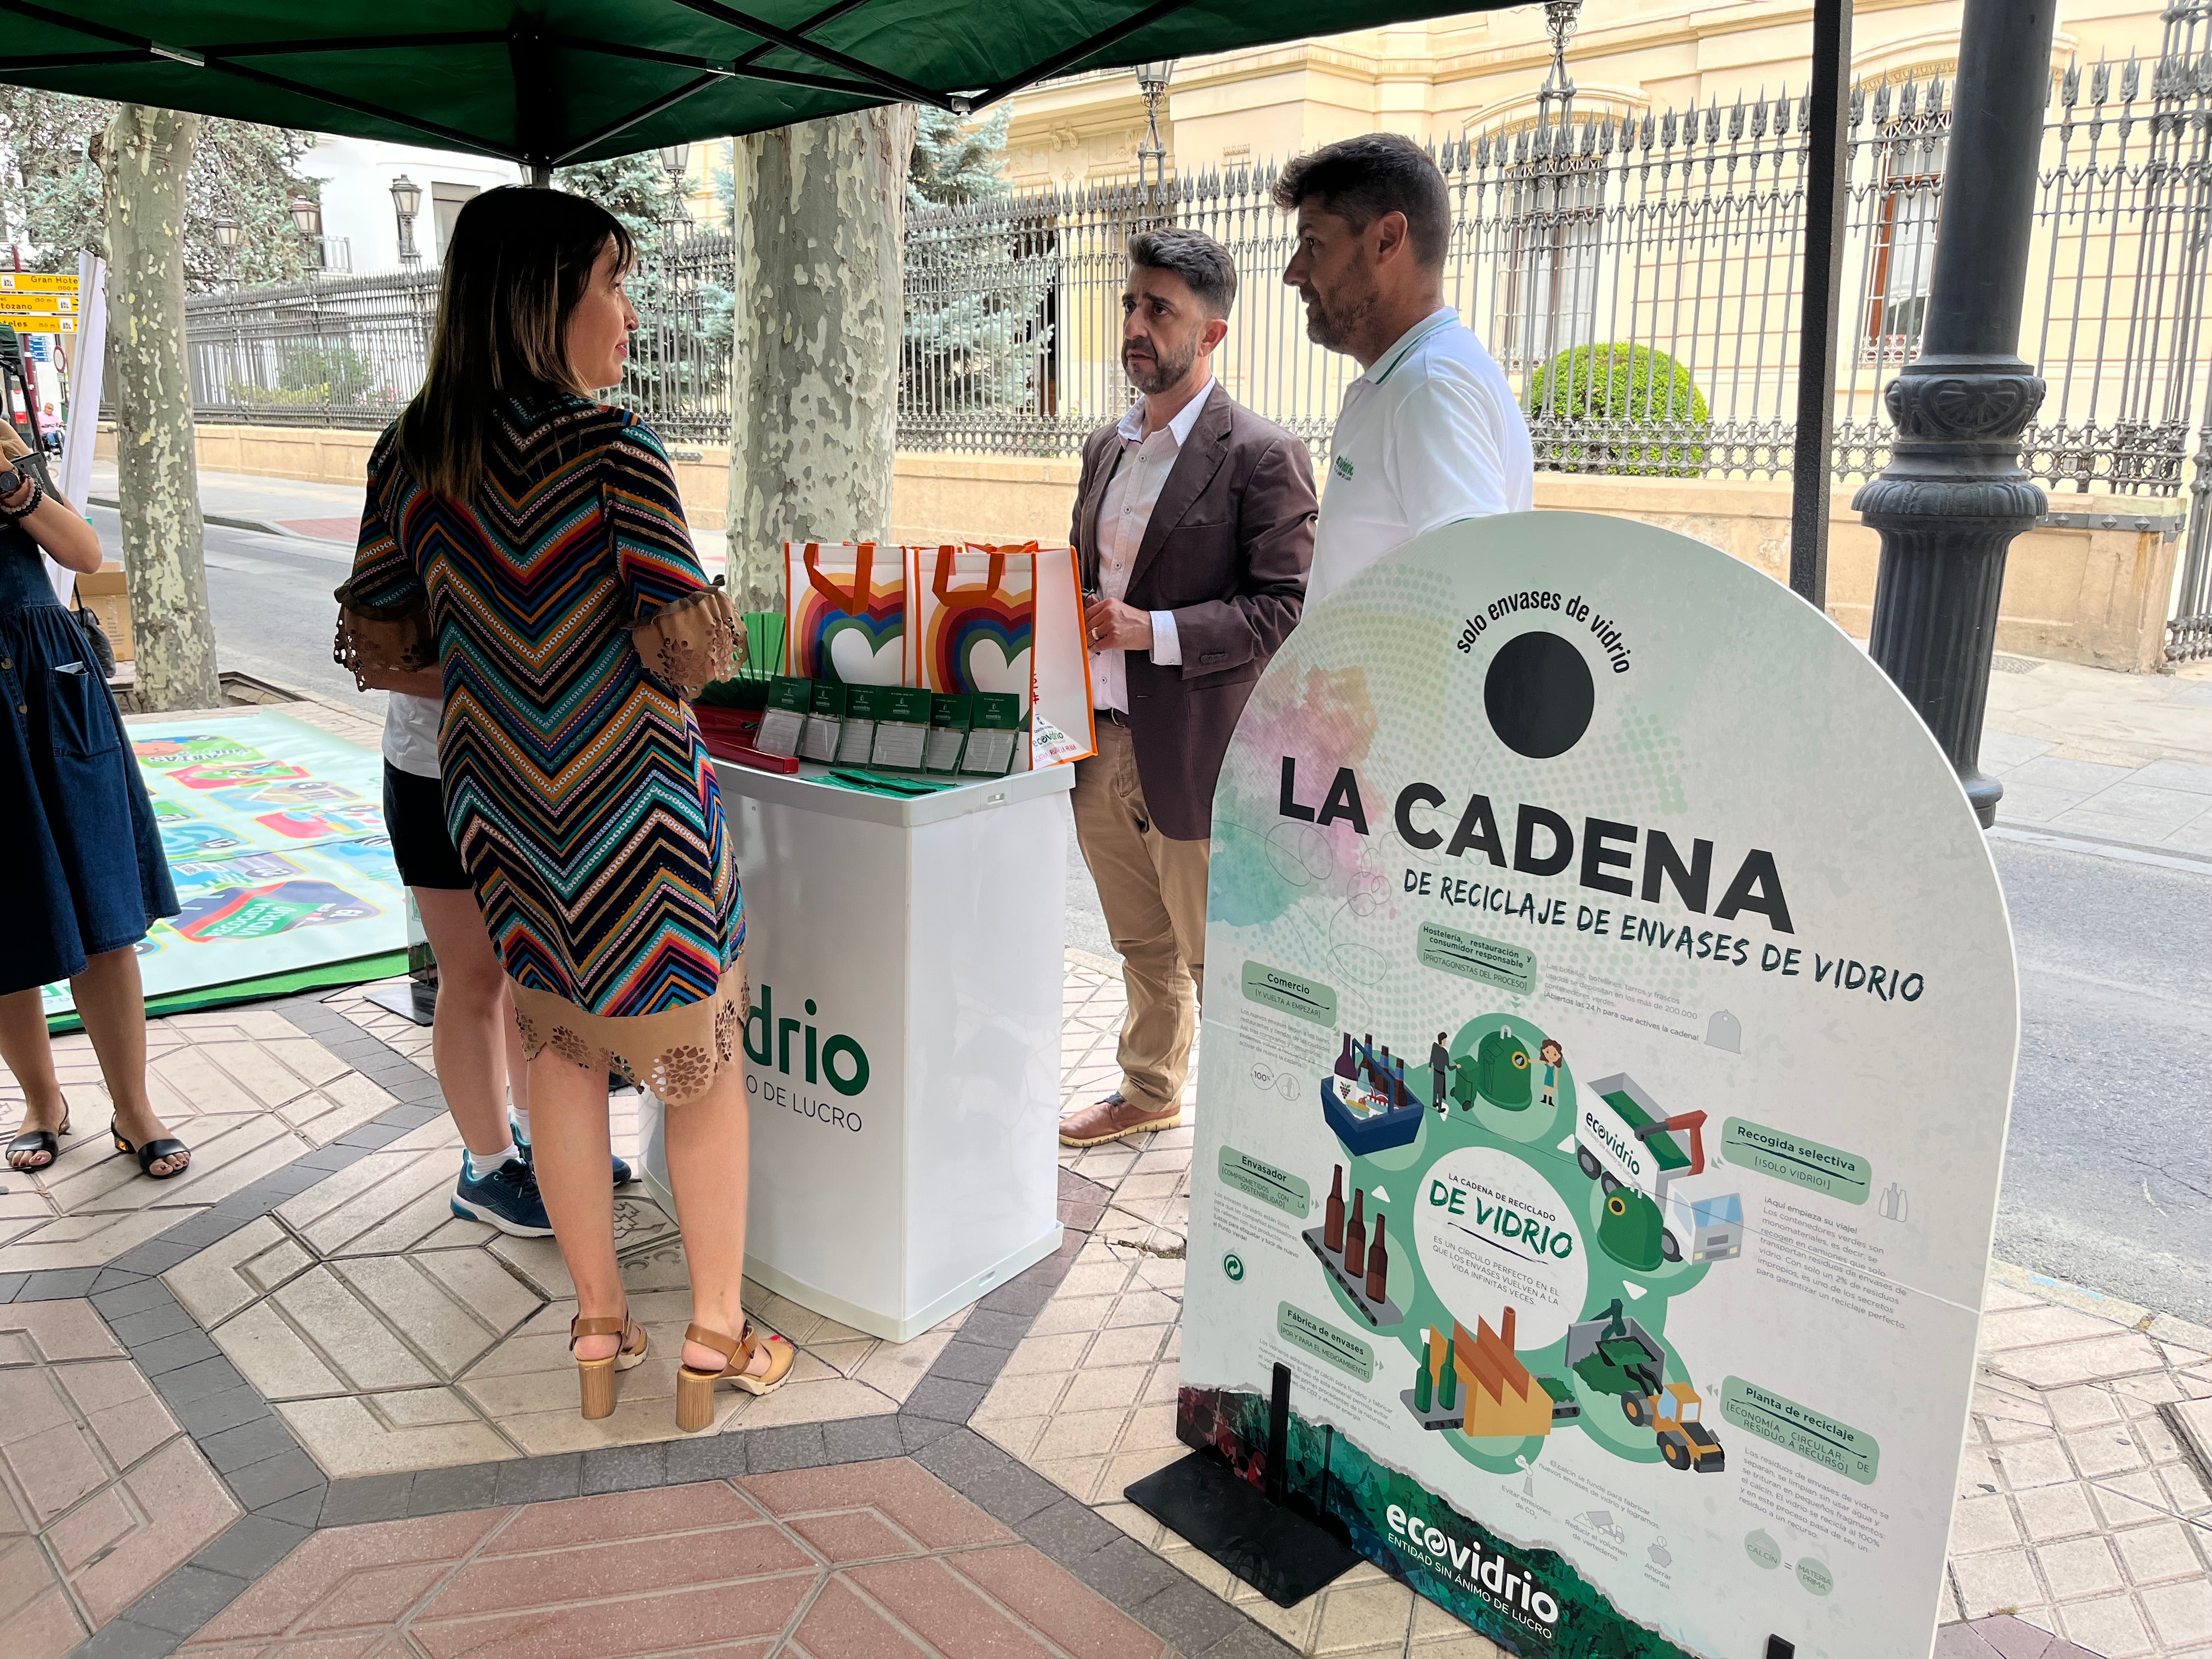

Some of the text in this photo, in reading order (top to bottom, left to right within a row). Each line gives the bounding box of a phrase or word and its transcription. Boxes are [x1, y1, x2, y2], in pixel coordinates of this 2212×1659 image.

[1458, 591, 1630, 673] solo envases de vidrio
[1032, 730, 1064, 747] ecovidrio
[1279, 755, 1795, 935] LA CADENA
[204, 902, 297, 937] RECOGIDA VIDRIO
[1404, 868, 1925, 1004] DE RECICLAJE DE ENVASES DE VIDRIO
[1423, 926, 1463, 944] Hostelería,
[1470, 939, 1519, 958] restauración
[1423, 952, 1527, 990] [PROTAGONISTAS DEL PROCESO]
[1430, 937, 1523, 968] consumidor responsable
[1255, 989, 1261, 997] [Y
[1263, 993, 1284, 1005] VUELTA
[1292, 1002, 1321, 1018] EMPEZAR]
[1267, 973, 1310, 994] Comercio
[1575, 1000, 1584, 1008] las
[1602, 1009, 1618, 1018] para
[1620, 1014, 1633, 1023] que
[1635, 1019, 1660, 1030] actives
[1670, 1029, 1699, 1041] cadena!
[1254, 1071, 1270, 1081] 100%
[764, 1081, 786, 1108] DE
[793, 1093, 862, 1132] LUCRO
[1585, 1112, 1640, 1175] ecovidrio
[1737, 1126, 1855, 1171] Recogida selectiva
[1222, 1167, 1305, 1210] [COMPROMETIDOS CON LA
[1242, 1155, 1286, 1182] Envasador
[1790, 1169, 1830, 1189] VIDRIO!]
[1240, 1183, 1285, 1209] SOSTENIBILIDAD]
[1448, 1173, 1556, 1221] LA CADENA DE RECICLADO
[1764, 1197, 1786, 1209] ¡Aquí
[1787, 1205, 1822, 1222] empieza
[1836, 1221, 1858, 1234] viaje!
[1430, 1180, 1573, 1259] DE VIDRIO
[1763, 1207, 1884, 1255] Los contenedores verdes son
[1433, 1245, 1448, 1256] QUE
[1450, 1252, 1464, 1264] LOS
[1466, 1260, 1500, 1279] ENVASES
[1503, 1276, 1538, 1297] VUELVEN
[1548, 1296, 1559, 1306] LA
[1434, 1235, 1560, 1296] ES UN CÍRCULO PERFECTO EN EL
[1452, 1263, 1536, 1306] VIDA INFINITAS VECES.
[1756, 1267, 1774, 1279] para
[1776, 1276, 1817, 1295] garantizar
[1832, 1296, 1866, 1314] reciclaje
[1867, 1310, 1906, 1330] perfecto.
[1281, 1325, 1293, 1338] [POR
[1299, 1335, 1313, 1348] PARA
[1322, 1348, 1369, 1379] MEDIOAMBIENTE]
[1288, 1309, 1364, 1356] Fábrica de envases
[1726, 1401, 1870, 1473] [ECONOMÍA CIRCULAR: DE
[1746, 1387, 1854, 1442] Planta de reciclaje
[1743, 1420, 1848, 1474] RESIDUO A RECURSO]
[1558, 1463, 1576, 1478] calcín
[1577, 1474, 1585, 1483] se
[1587, 1477, 1606, 1493] funde
[1607, 1489, 1622, 1502] para
[1624, 1497, 1650, 1516] fabricar
[1745, 1447, 1889, 1520] Los residuos de envases de vidrio se
[1386, 1504, 1559, 1623] ecovidrio
[1645, 1563, 1672, 1581] Ahorrar
[1747, 1544, 1778, 1564] CALCÍN
[1798, 1564, 1831, 1585] MATERIA
[1388, 1532, 1552, 1639] ENTIDAD SIN ÁNIMO DE LUCRO
[1644, 1572, 1671, 1590] energía
[1803, 1575, 1826, 1591] PRIMA
